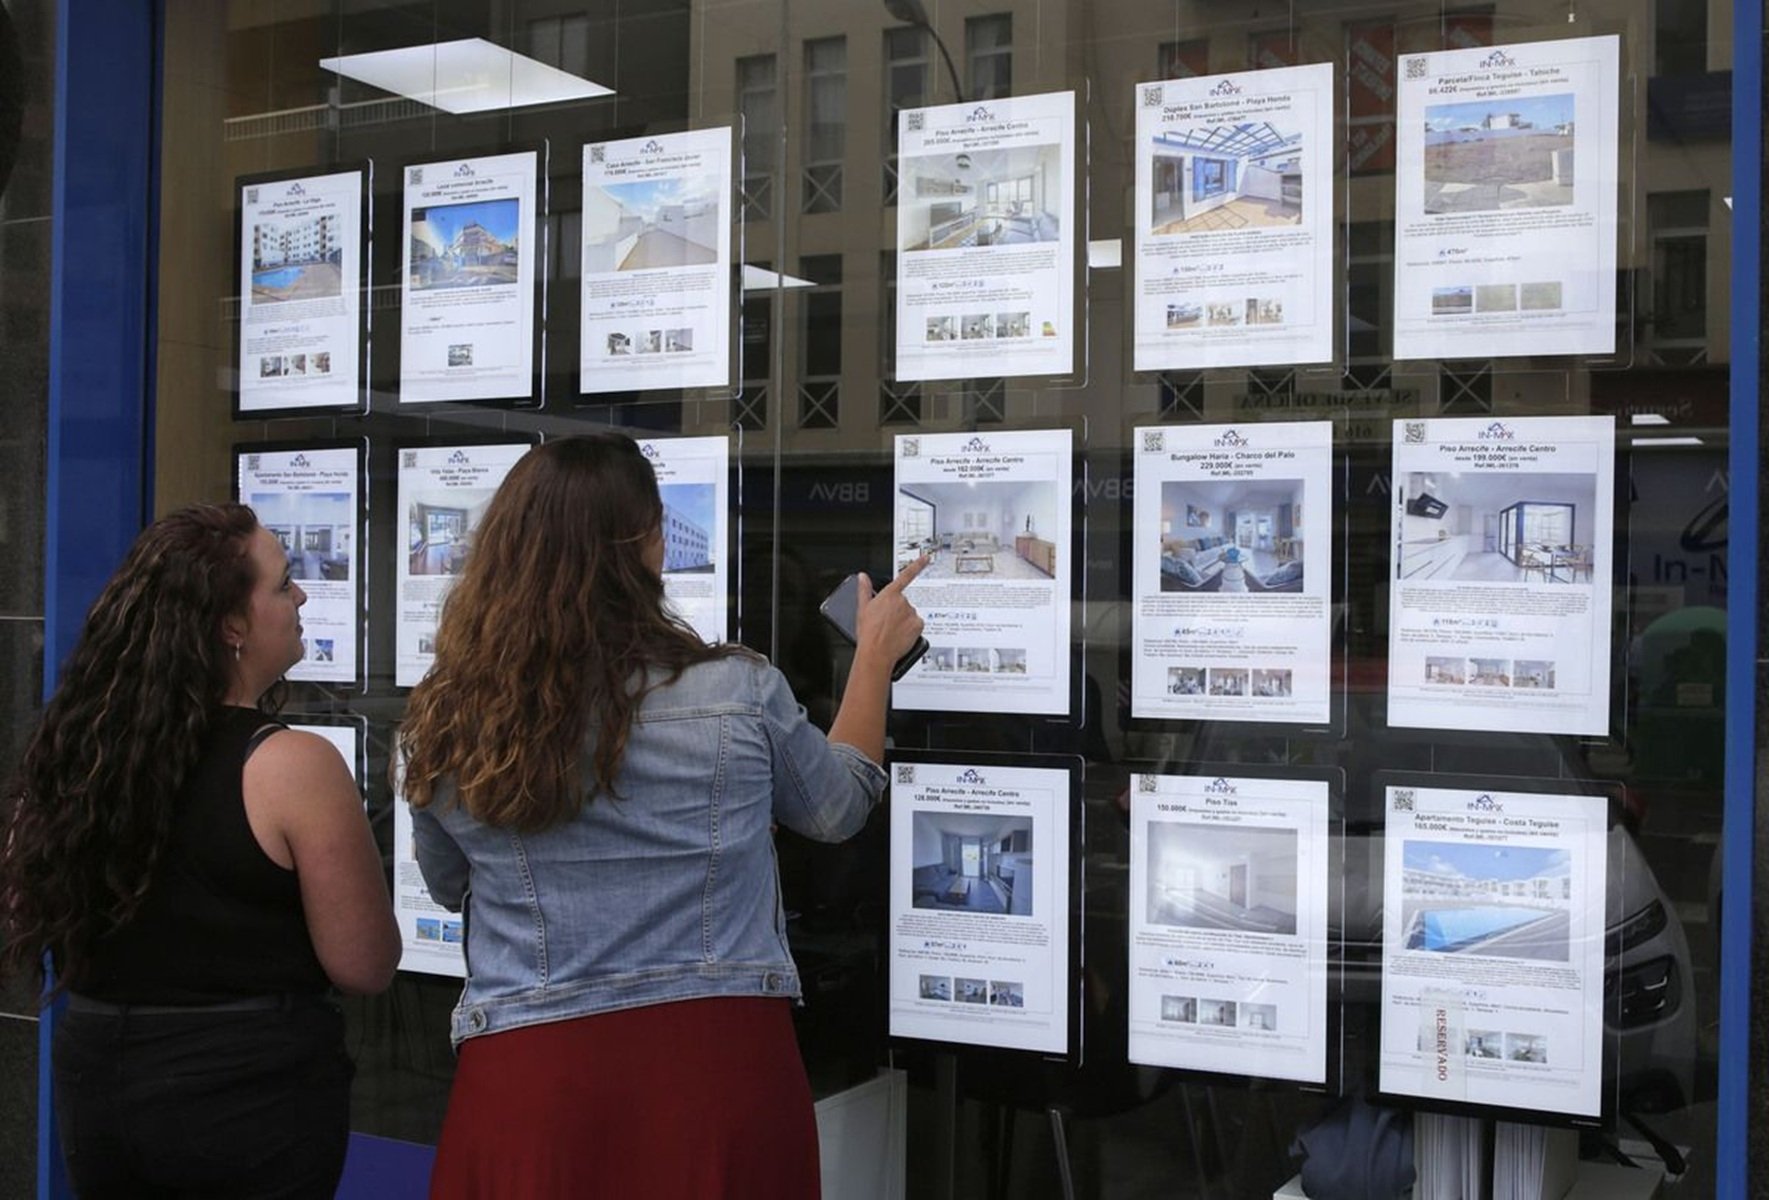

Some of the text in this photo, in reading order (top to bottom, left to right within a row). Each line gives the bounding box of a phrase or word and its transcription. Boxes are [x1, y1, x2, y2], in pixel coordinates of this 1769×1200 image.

[1247, 97, 1266, 106] Playa
[1268, 95, 1291, 103] Honda
[1440, 444, 1457, 453] Piso
[1458, 444, 1489, 453] Arrecife
[1495, 444, 1527, 453] Arrecife
[1529, 444, 1556, 453] Centro
[946, 457, 971, 465] Arrecife
[1171, 453, 1208, 463] Bungalow
[1235, 451, 1262, 460] Charco
[1264, 451, 1276, 459] del
[1278, 451, 1295, 459] Palo
[925, 786, 940, 794] Piso
[940, 787, 966, 796] Arrecife
[971, 789, 997, 797] Arrecife
[998, 790, 1020, 798] Centro
[1205, 798, 1221, 806] Piso
[1415, 813, 1465, 824] Apartamento
[1466, 816, 1496, 826] Teguise
[1503, 818, 1527, 827] Costa
[1529, 819, 1559, 829] Teguise
[1436, 1008, 1448, 1082] RESERVADO
